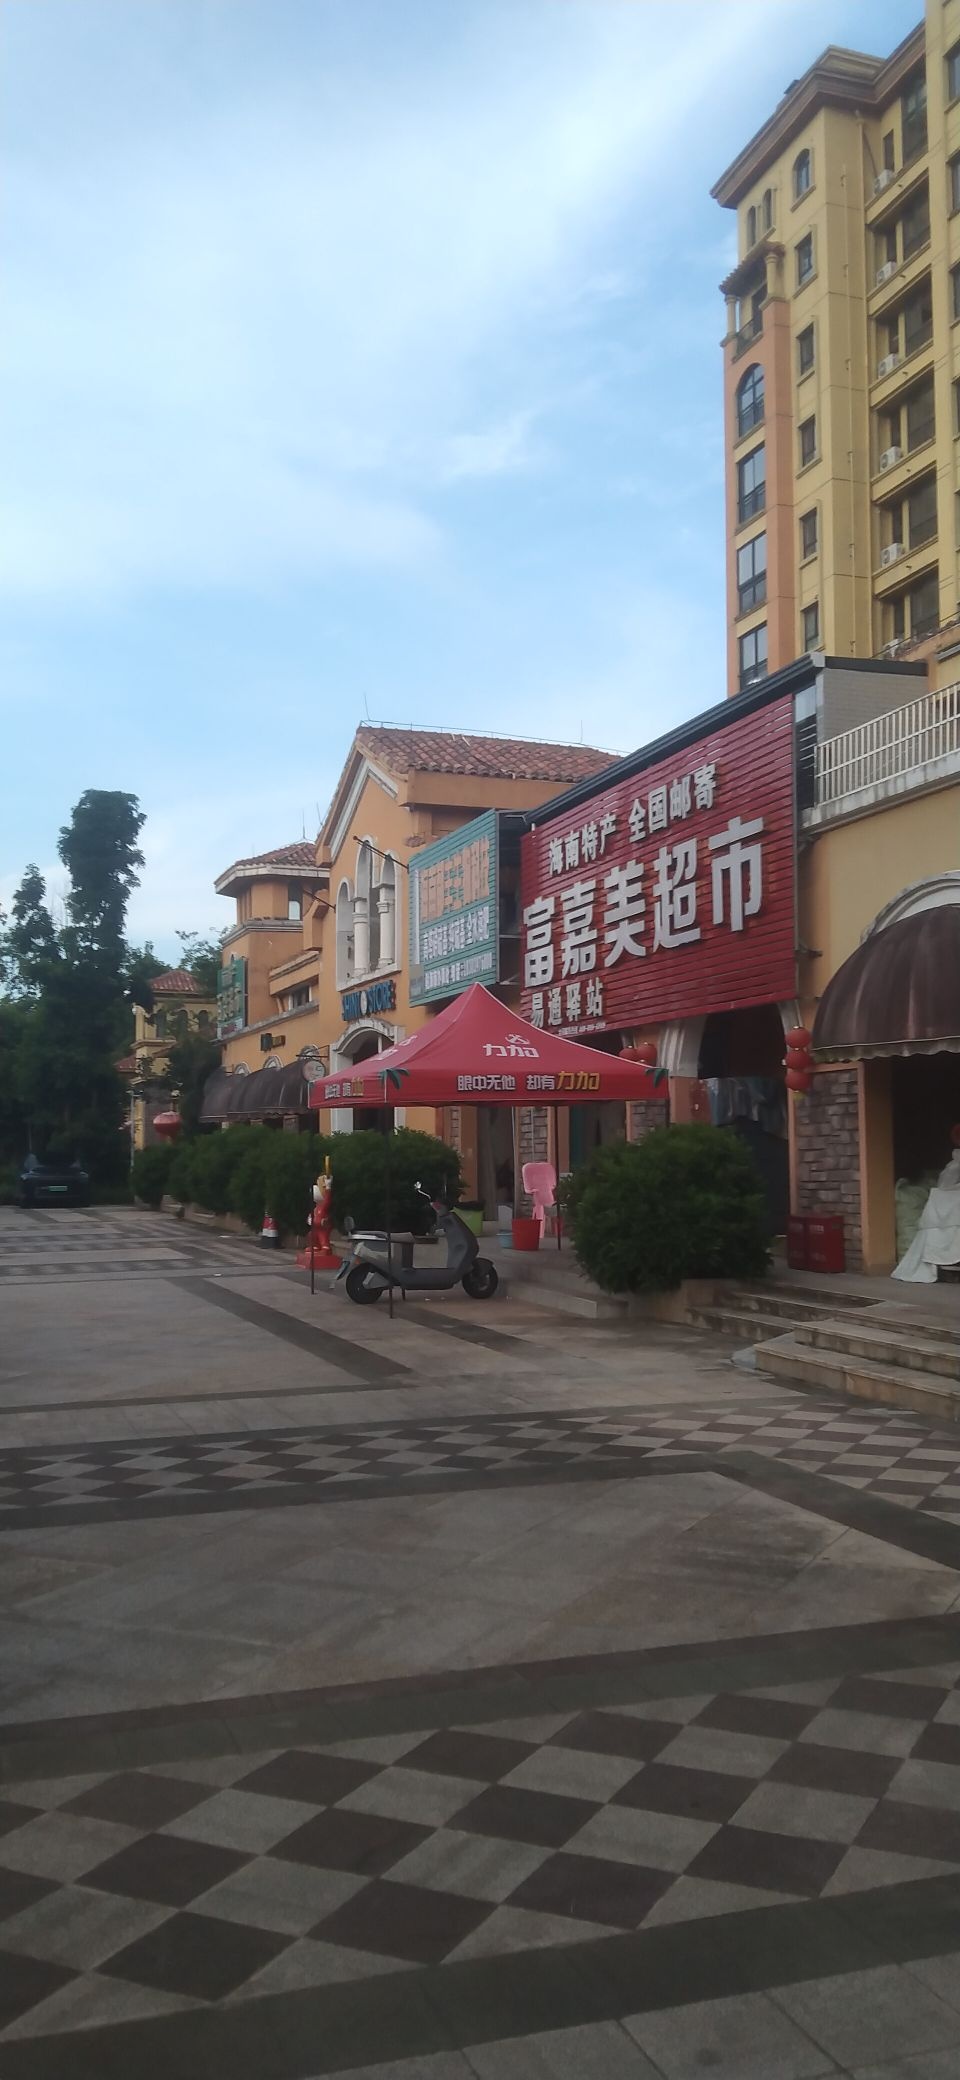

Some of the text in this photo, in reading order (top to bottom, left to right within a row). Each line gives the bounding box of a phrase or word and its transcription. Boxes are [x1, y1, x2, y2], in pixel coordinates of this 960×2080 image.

[549, 763, 717, 876] 海南特产 全国邮寄
[523, 816, 764, 988] 富嘉美超市
[530, 976, 604, 1028] 易通驿站
[482, 1043, 540, 1058] 力加
[457, 1070, 600, 1091] 眼中无他 却有力加
